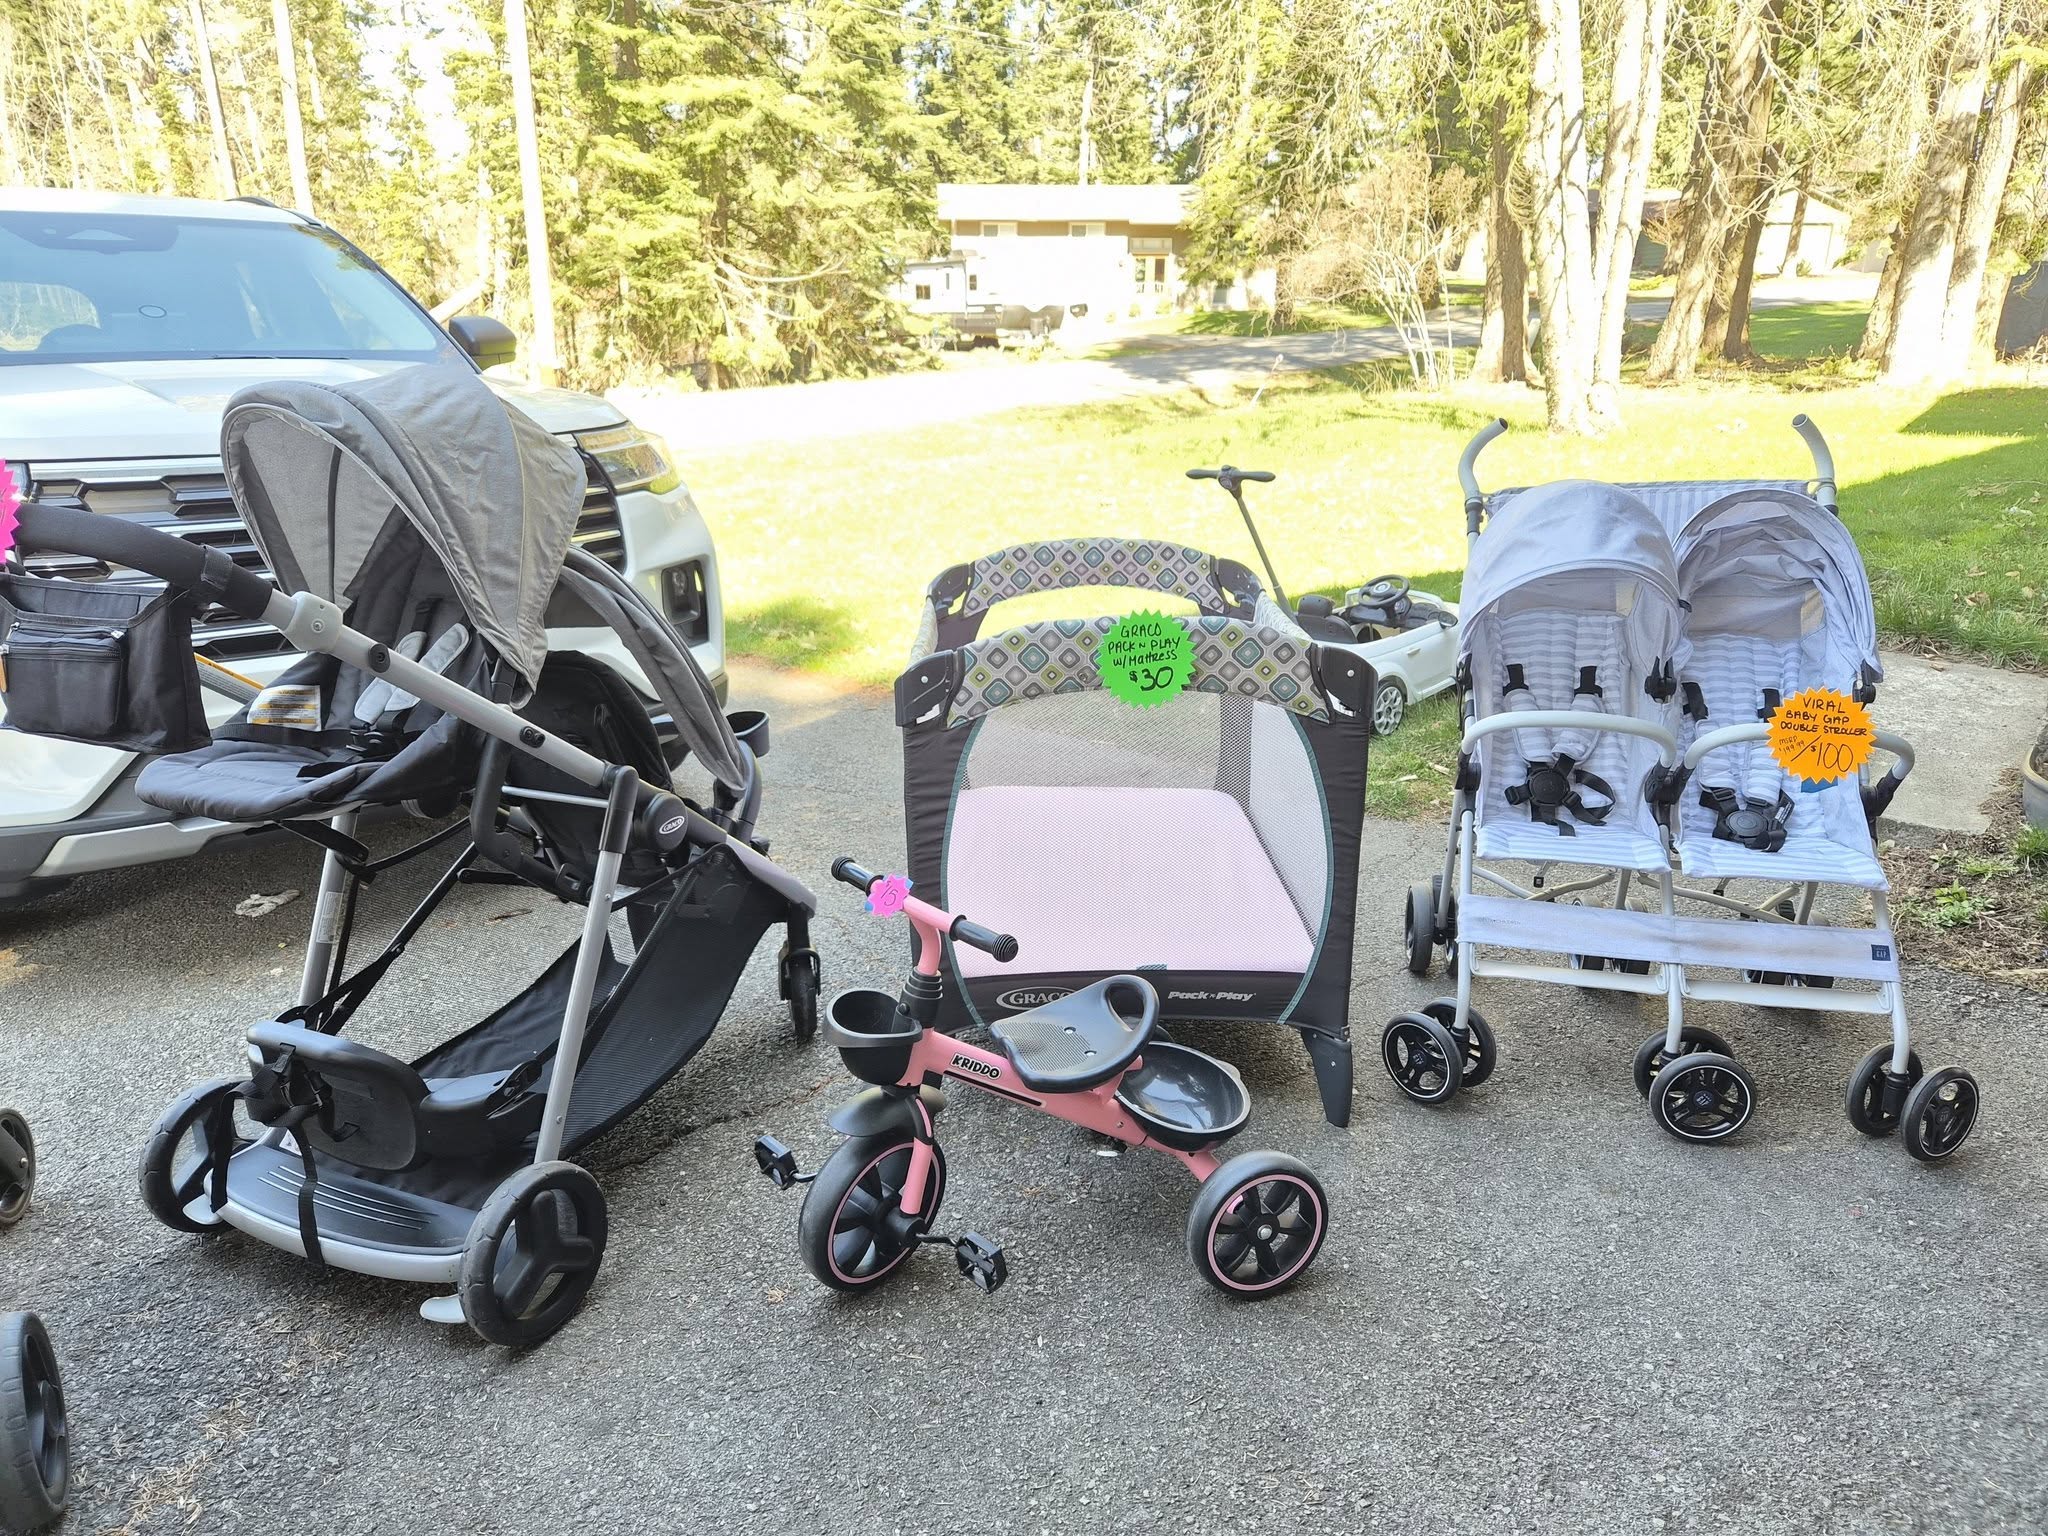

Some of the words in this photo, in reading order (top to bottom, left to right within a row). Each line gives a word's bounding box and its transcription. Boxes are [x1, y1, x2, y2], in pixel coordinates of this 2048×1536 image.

[1120, 622, 1162, 638] GRACO
[1107, 641, 1135, 655] PACK
[1150, 636, 1181, 651] PLAY
[1128, 666, 1174, 692] $30
[1803, 697, 1846, 714] VIRAL
[1785, 710, 1818, 721] BABY
[1823, 714, 1850, 725] GAP
[1780, 721, 1819, 732] DOUBLE
[1823, 725, 1867, 736] STROLLER
[1810, 742, 1854, 773] $100
[1167, 991, 1209, 1000] Pack
[1216, 991, 1254, 1002] Play
[951, 1054, 1000, 1078] KRIDDO
